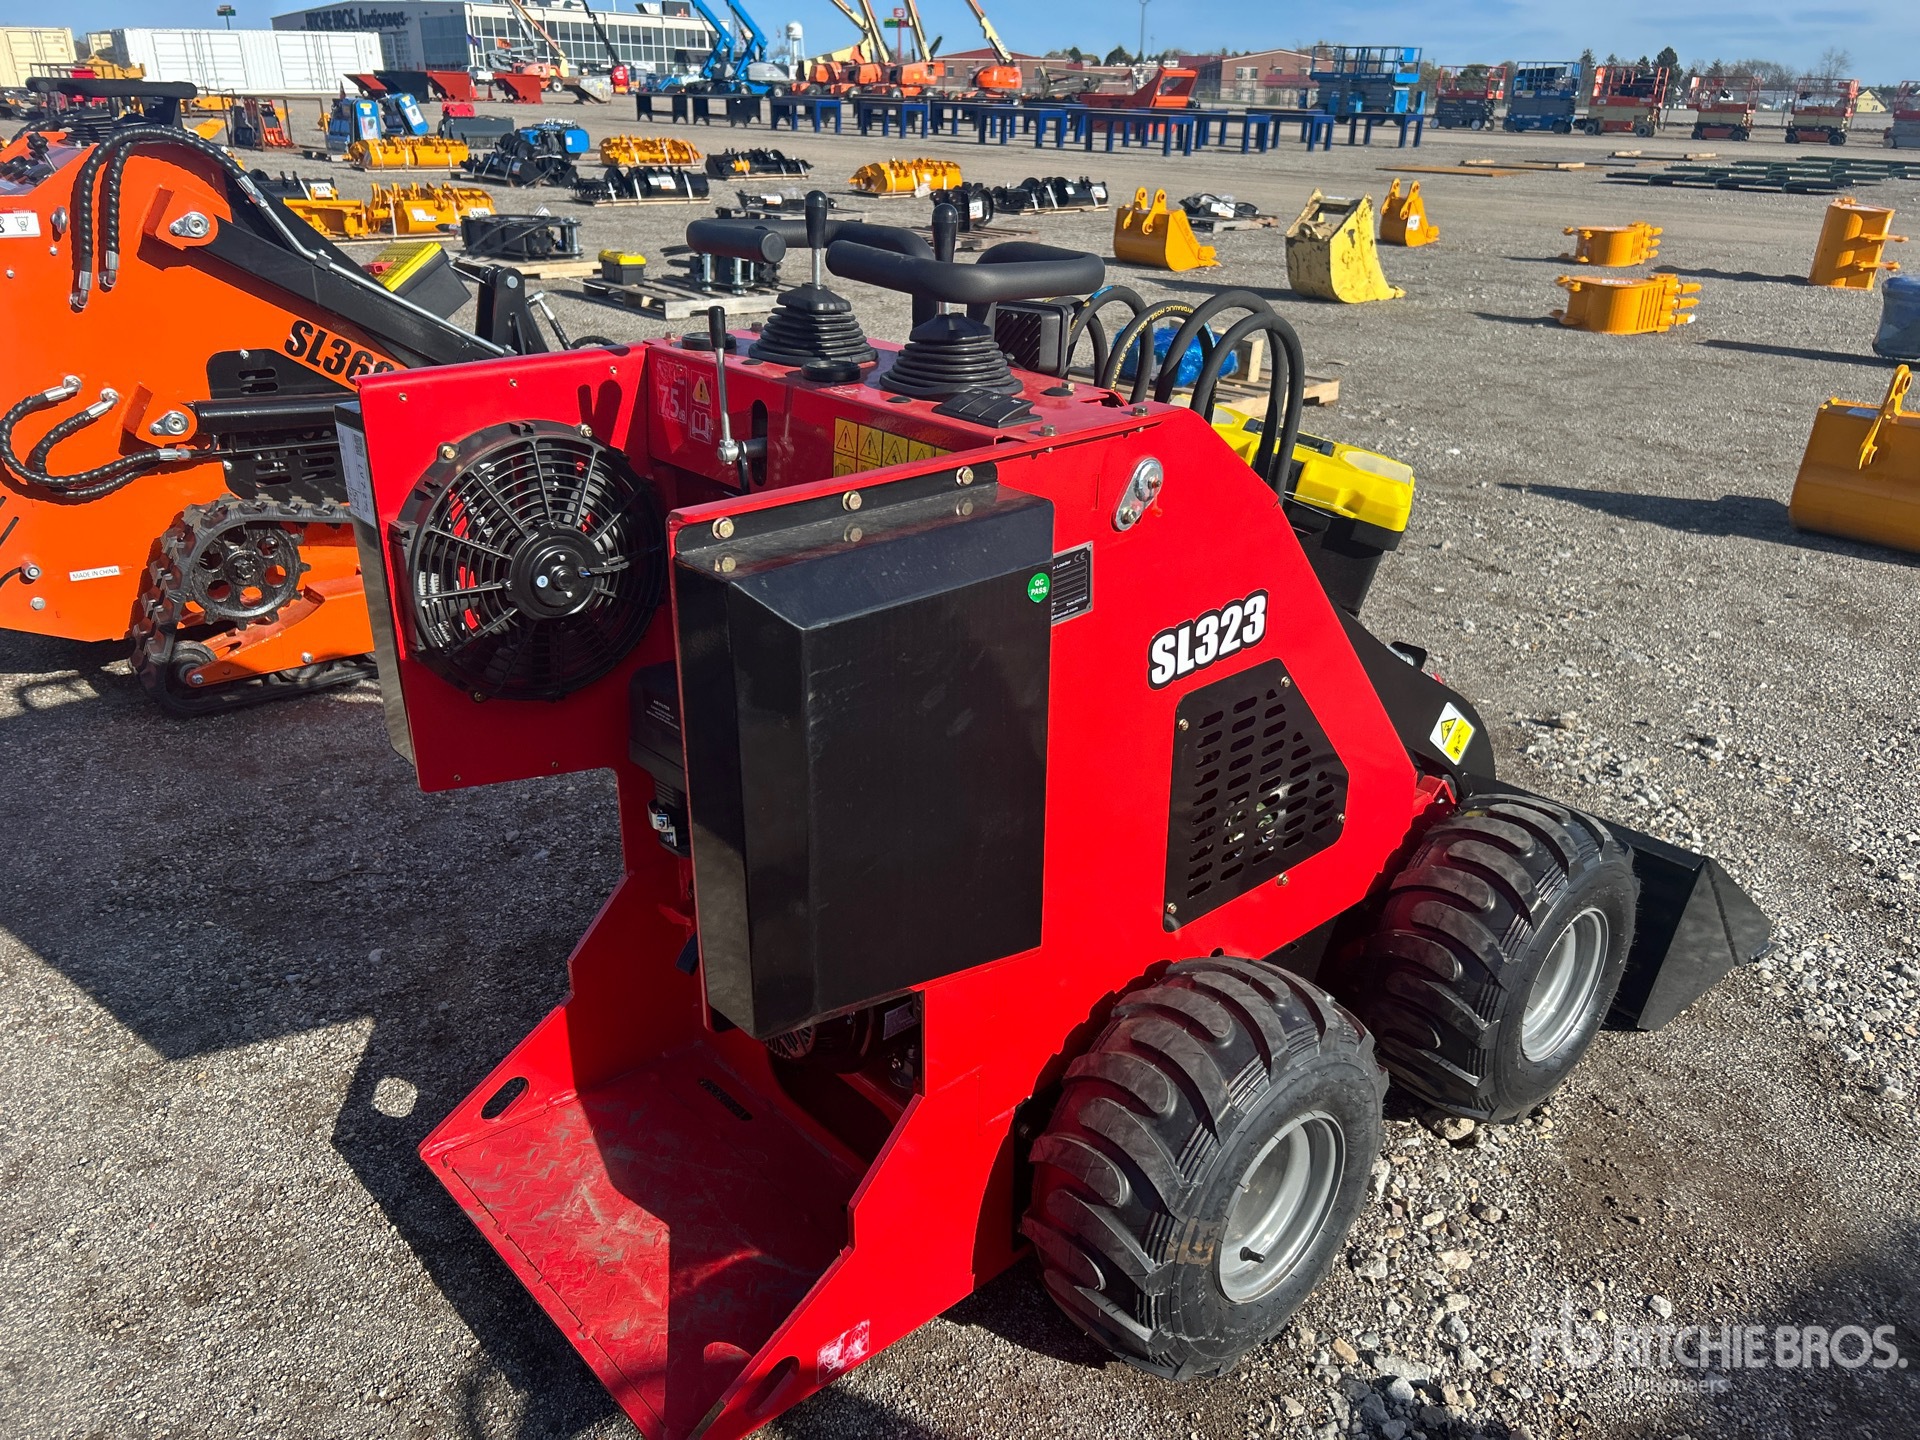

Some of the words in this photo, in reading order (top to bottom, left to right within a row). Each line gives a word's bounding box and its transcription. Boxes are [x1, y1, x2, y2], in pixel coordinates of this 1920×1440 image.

[72, 571, 91, 579] MADE
[99, 568, 118, 576] CHINA
[1034, 578, 1045, 588] QC
[1030, 586, 1047, 596] PASS
[1150, 593, 1267, 686] SL323
